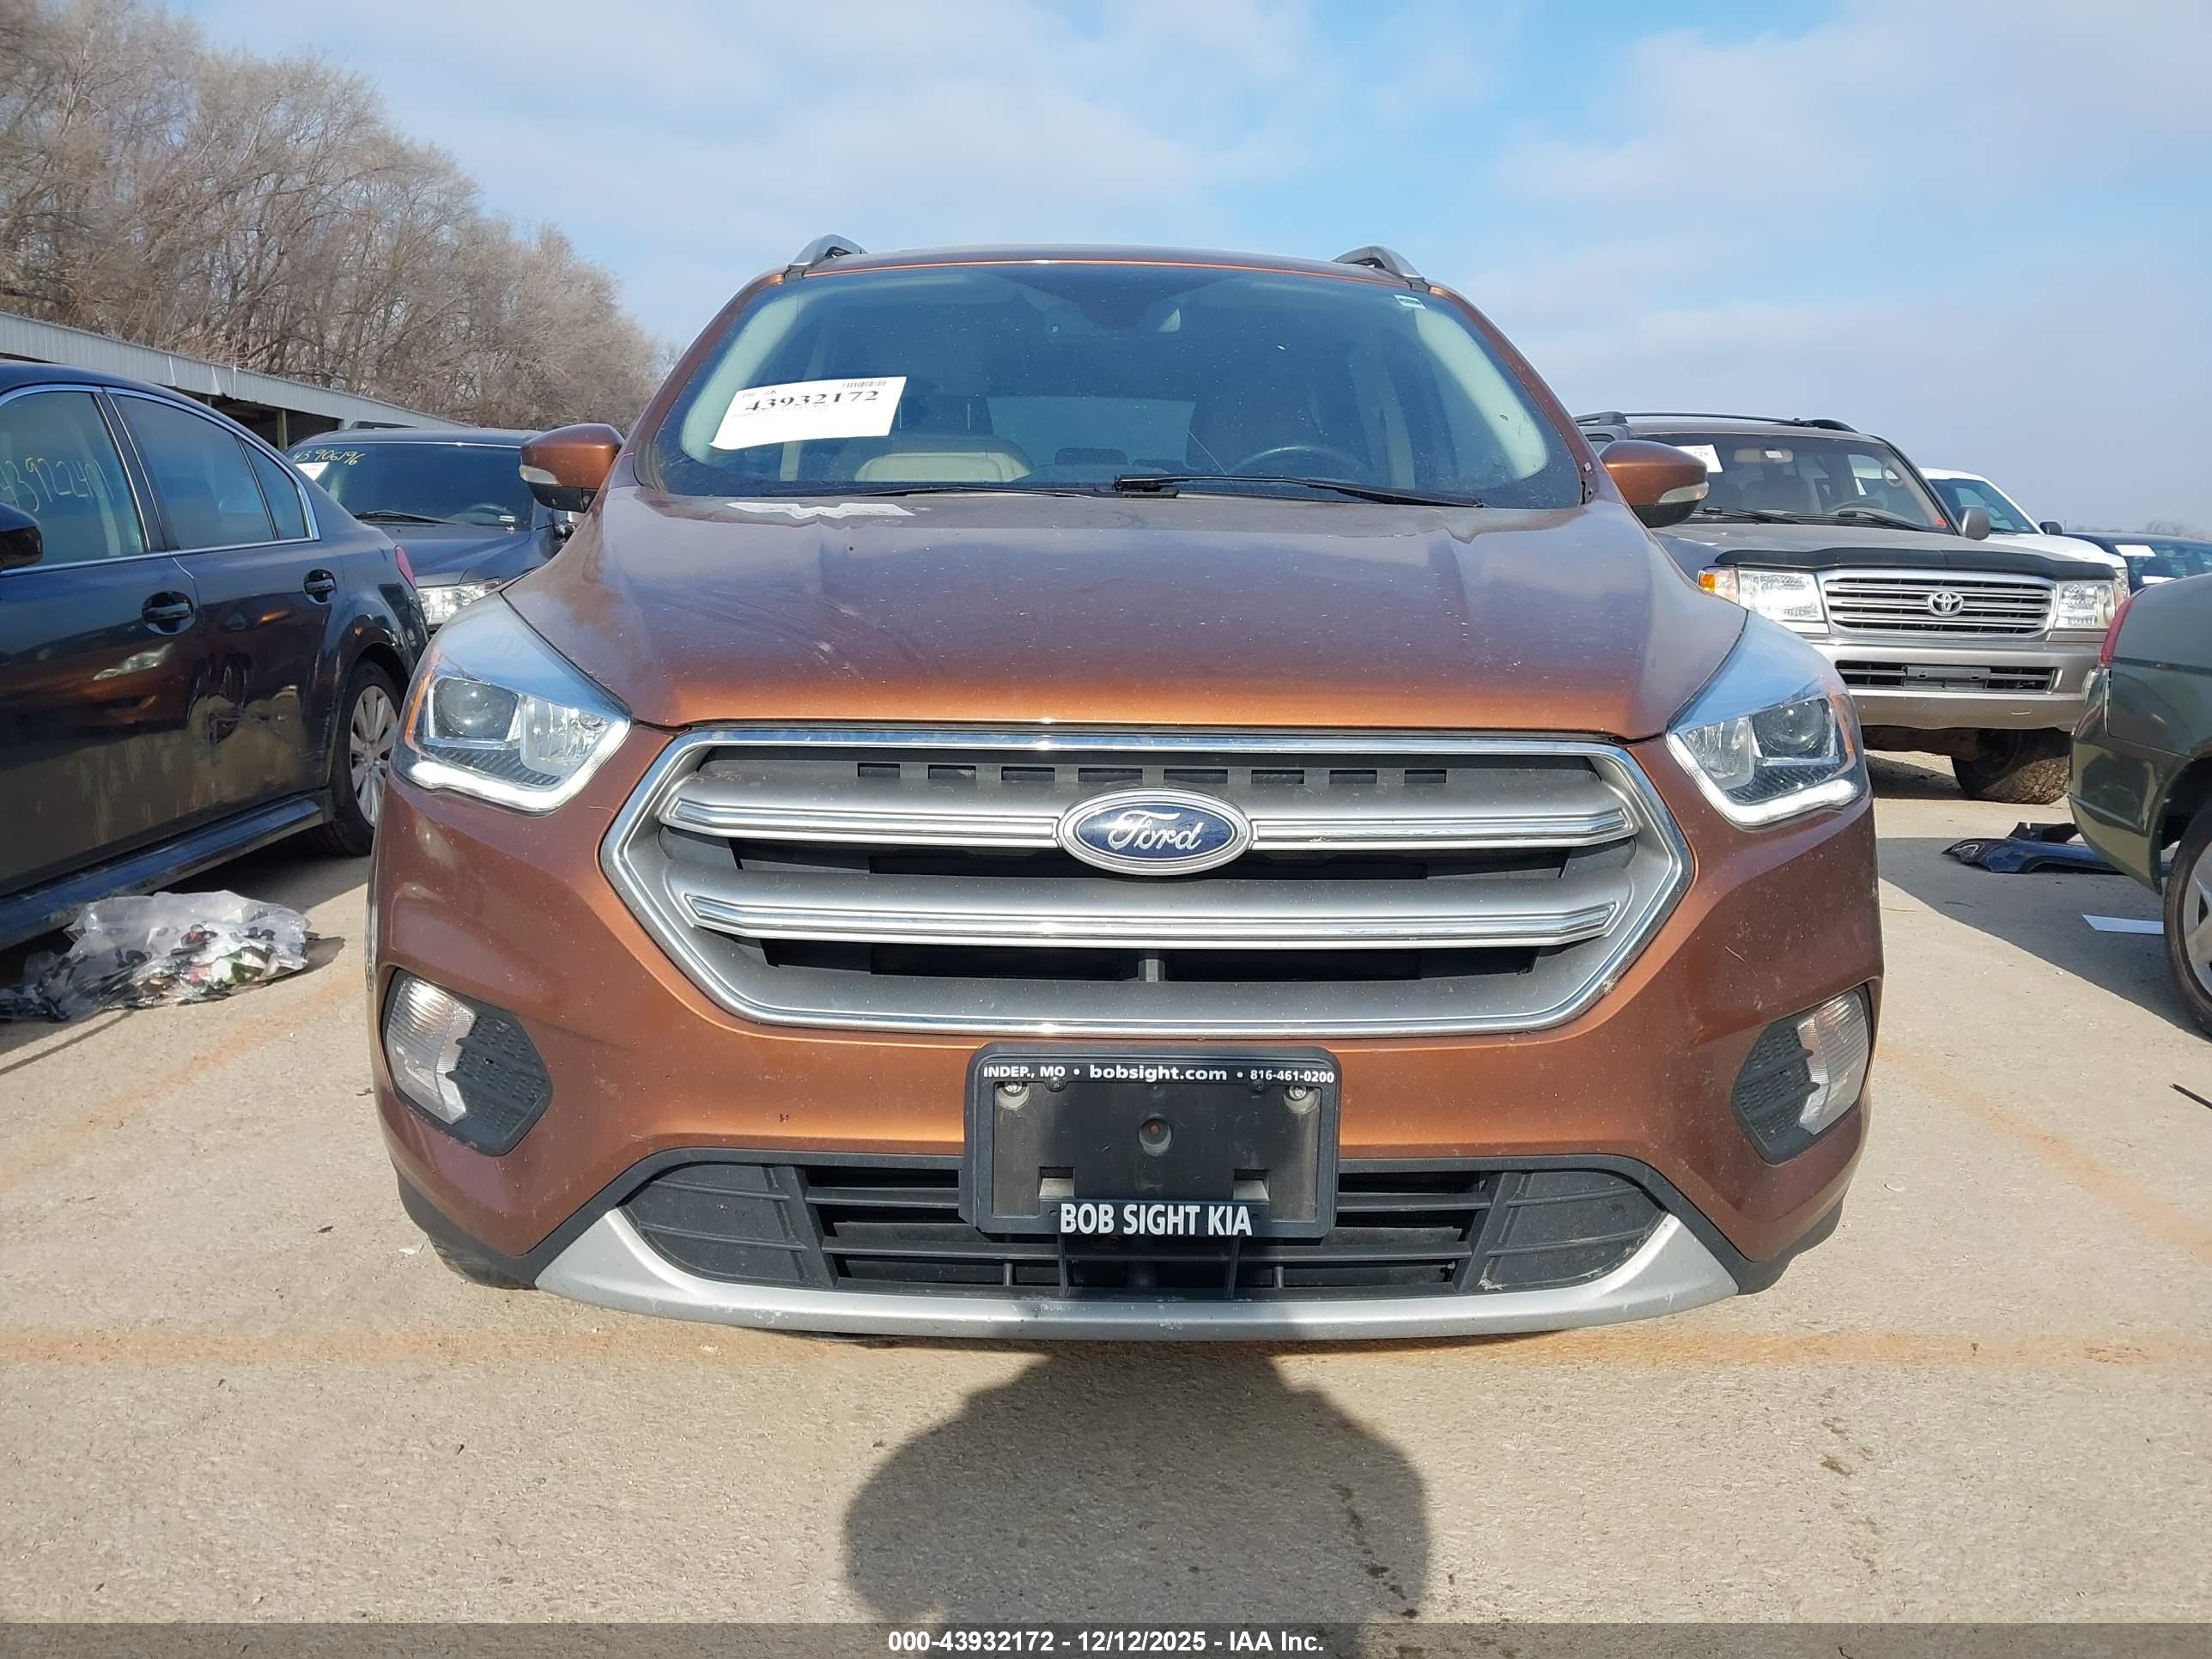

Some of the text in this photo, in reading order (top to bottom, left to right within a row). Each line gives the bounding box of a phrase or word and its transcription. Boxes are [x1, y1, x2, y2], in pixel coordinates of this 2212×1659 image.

[745, 390, 879, 411] 43932172
[1107, 810, 1205, 850] Ford
[983, 1064, 1335, 1084] INDEP., MO bobsight.com 816-461-0200
[1060, 1203, 1253, 1236] BOB SIGHT KIA
